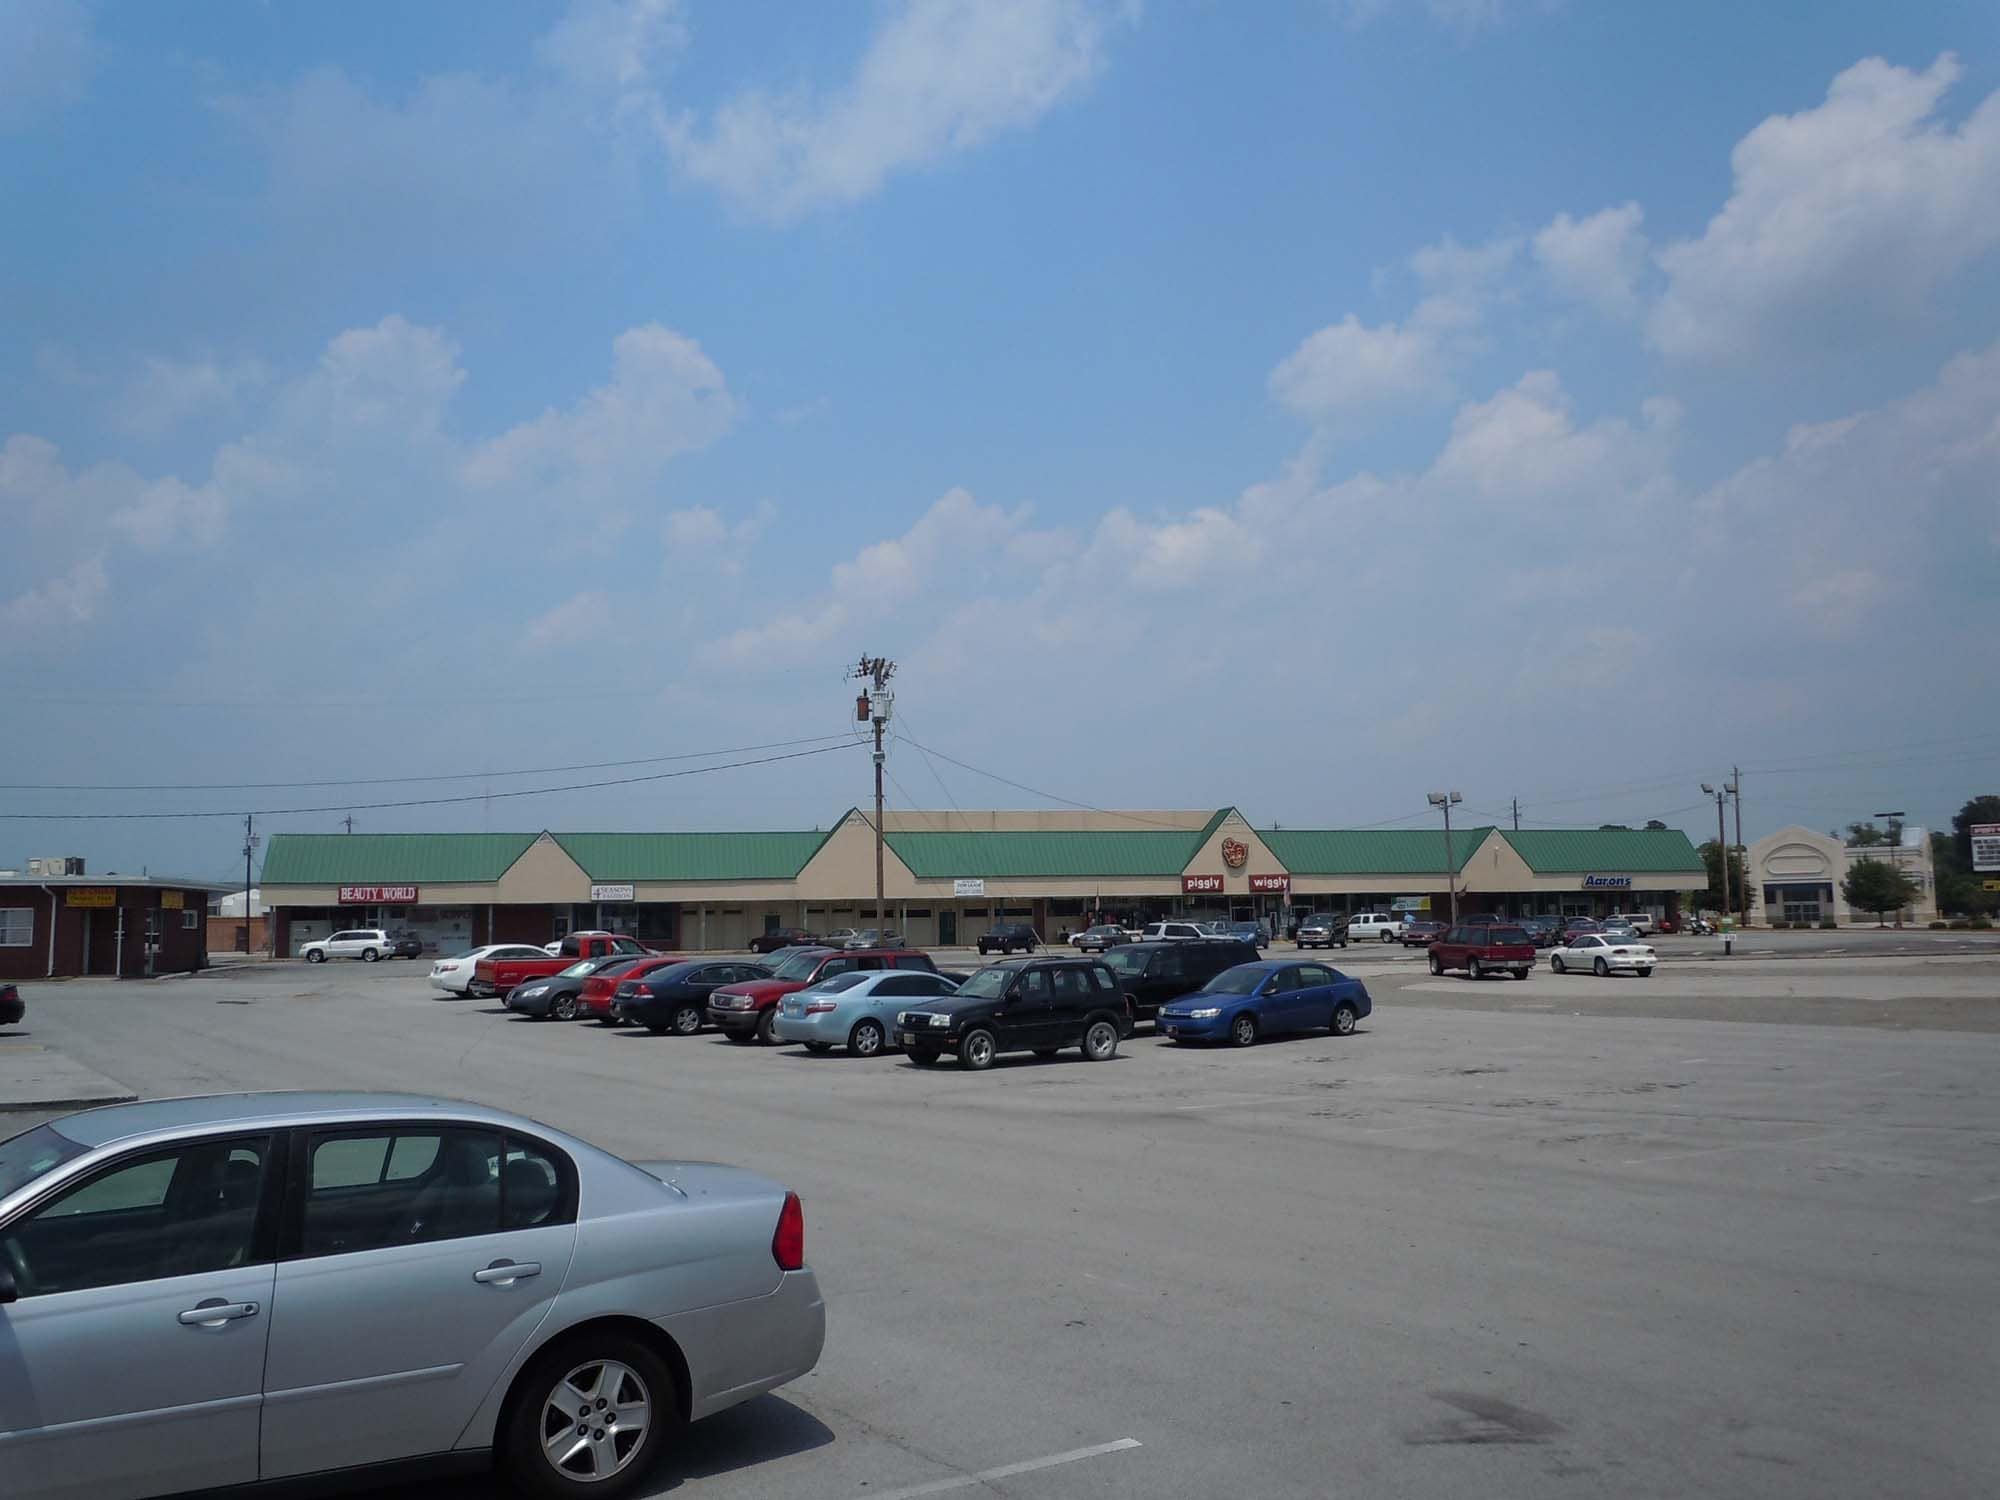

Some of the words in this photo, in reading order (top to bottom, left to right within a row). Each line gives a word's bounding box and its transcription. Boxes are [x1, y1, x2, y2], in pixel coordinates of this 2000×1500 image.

[1187, 877, 1220, 889] piggly
[1253, 876, 1288, 889] wiggly
[1585, 875, 1632, 886] Aarons
[341, 887, 378, 900] BEAUTY
[383, 887, 416, 900] WORLD
